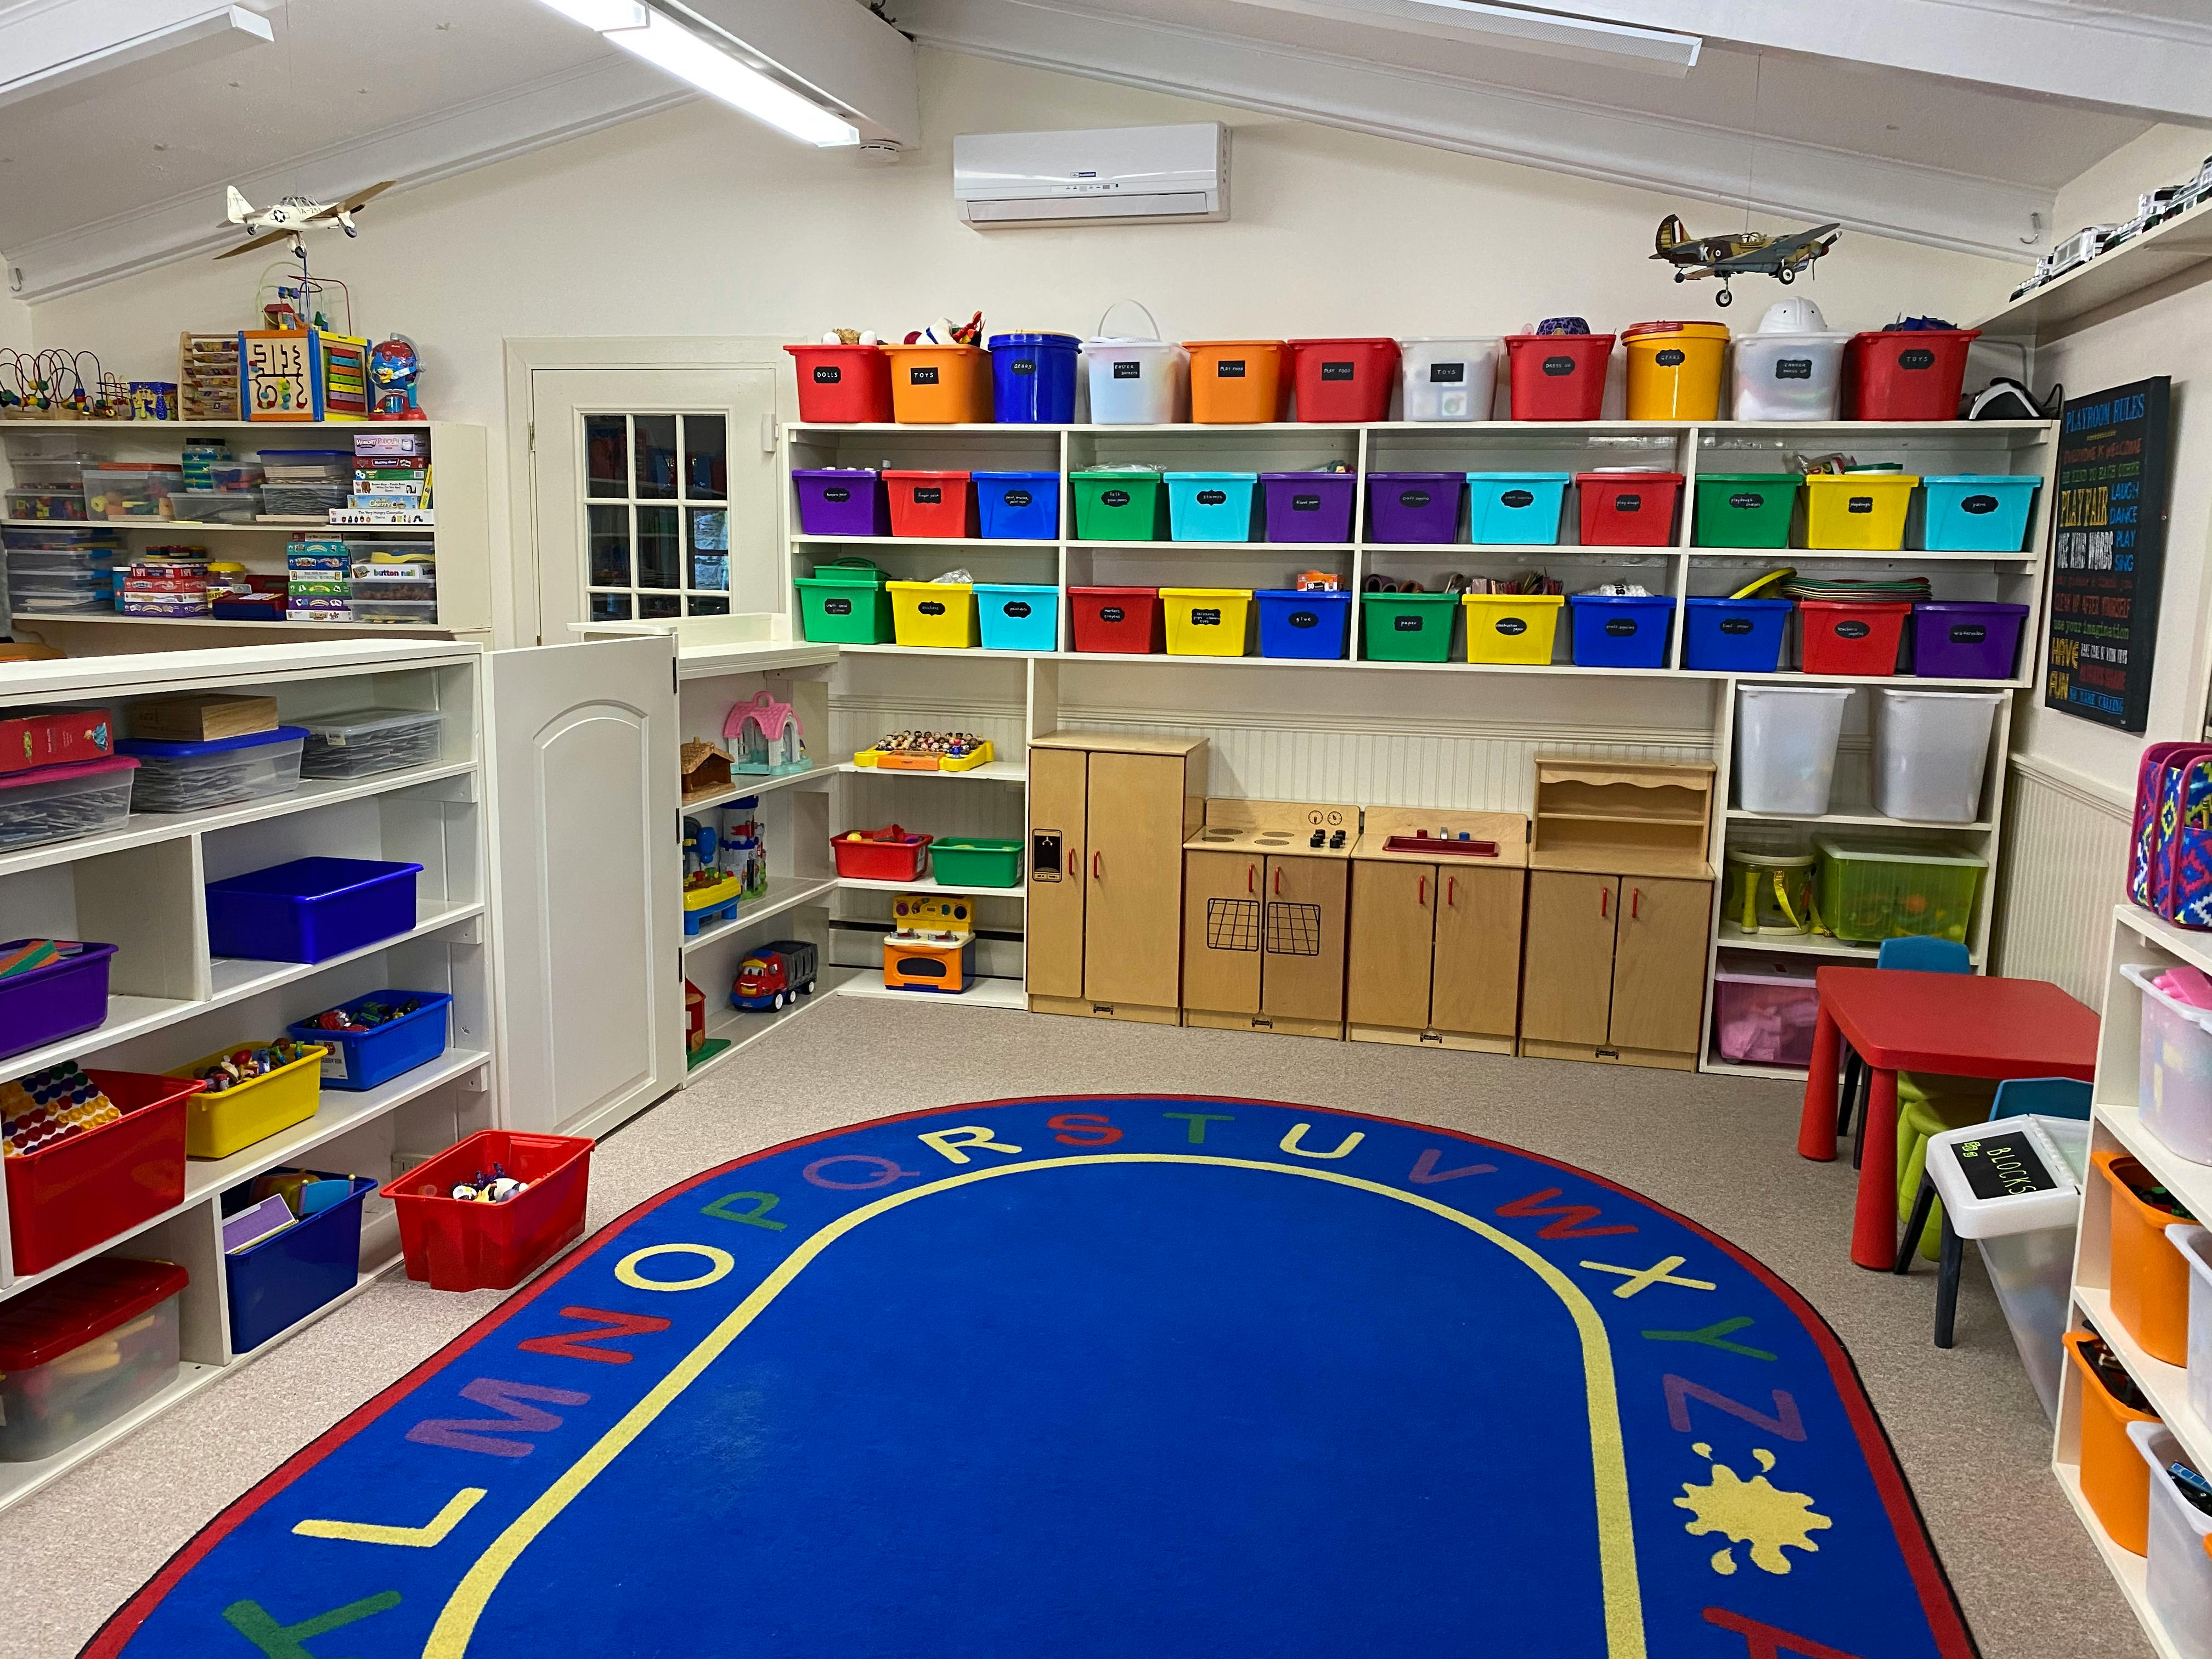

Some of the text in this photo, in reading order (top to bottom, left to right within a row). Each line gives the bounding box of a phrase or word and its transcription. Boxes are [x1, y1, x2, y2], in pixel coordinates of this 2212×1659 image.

[1700, 246, 1709, 261] K
[2066, 393, 2145, 433] PLAYROOM RULES
[356, 438, 377, 447] MEMORY
[2060, 487, 2108, 527] PLAY FAIR
[2111, 482, 2139, 500] LAUGH
[2109, 505, 2138, 525] DANCE
[2116, 529, 2137, 548] PLAY
[2115, 554, 2134, 571] SING
[2054, 619, 2129, 640] use your imagination
[2051, 637, 2080, 670] HAVE
[2049, 671, 2069, 701] FUN
[918, 1125, 1023, 1164] R
[1046, 1114, 1124, 1147] S
[1162, 1112, 1235, 1144] T
[1279, 1122, 1365, 1159] U
[803, 1155, 920, 1189] Q
[1408, 1149, 1498, 1184] V
[1987, 1147, 2037, 1195] BLOCKS
[700, 1190, 788, 1232] P
[1495, 1187, 1639, 1240] W
[614, 1243, 735, 1292] O
[1580, 1255, 1717, 1299] X
[517, 1305, 673, 1364] N
[1640, 1316, 1778, 1362] Y
[404, 1378, 591, 1458] M
[1663, 1373, 1807, 1443] Z
[292, 1486, 488, 1548] L
